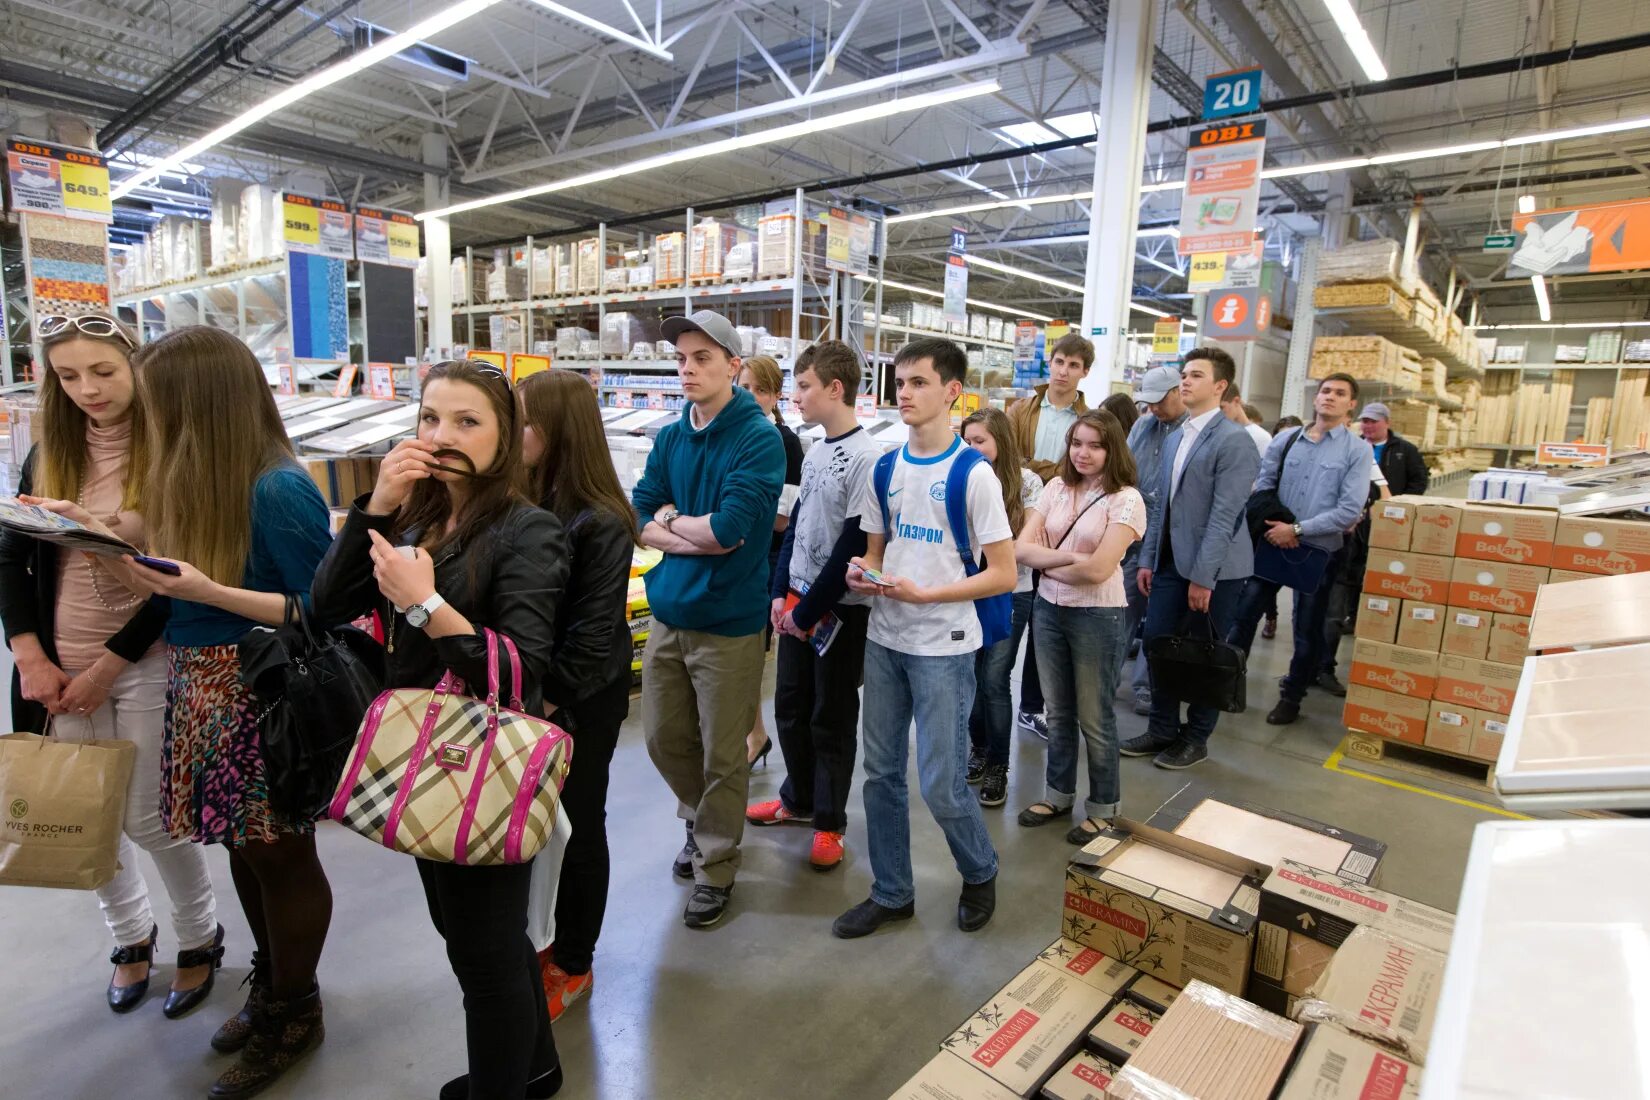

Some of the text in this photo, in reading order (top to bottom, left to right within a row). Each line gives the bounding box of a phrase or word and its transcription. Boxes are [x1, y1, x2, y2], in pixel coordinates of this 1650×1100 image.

[1213, 79, 1251, 111] 20
[1200, 123, 1255, 144] OBI
[14, 143, 101, 165] OBI OBI
[287, 194, 346, 213] OBI OBI
[361, 208, 383, 219] OBI
[391, 214, 413, 224] OBI
[954, 234, 965, 249] 13
[1355, 741, 1375, 755] EPAL
[5, 821, 84, 834] YVES ROCHER
[1080, 902, 1139, 933] KERAMIN
[1366, 941, 1416, 1021] КЕРАМИН
[988, 1012, 1034, 1057] КЕРАМИН
